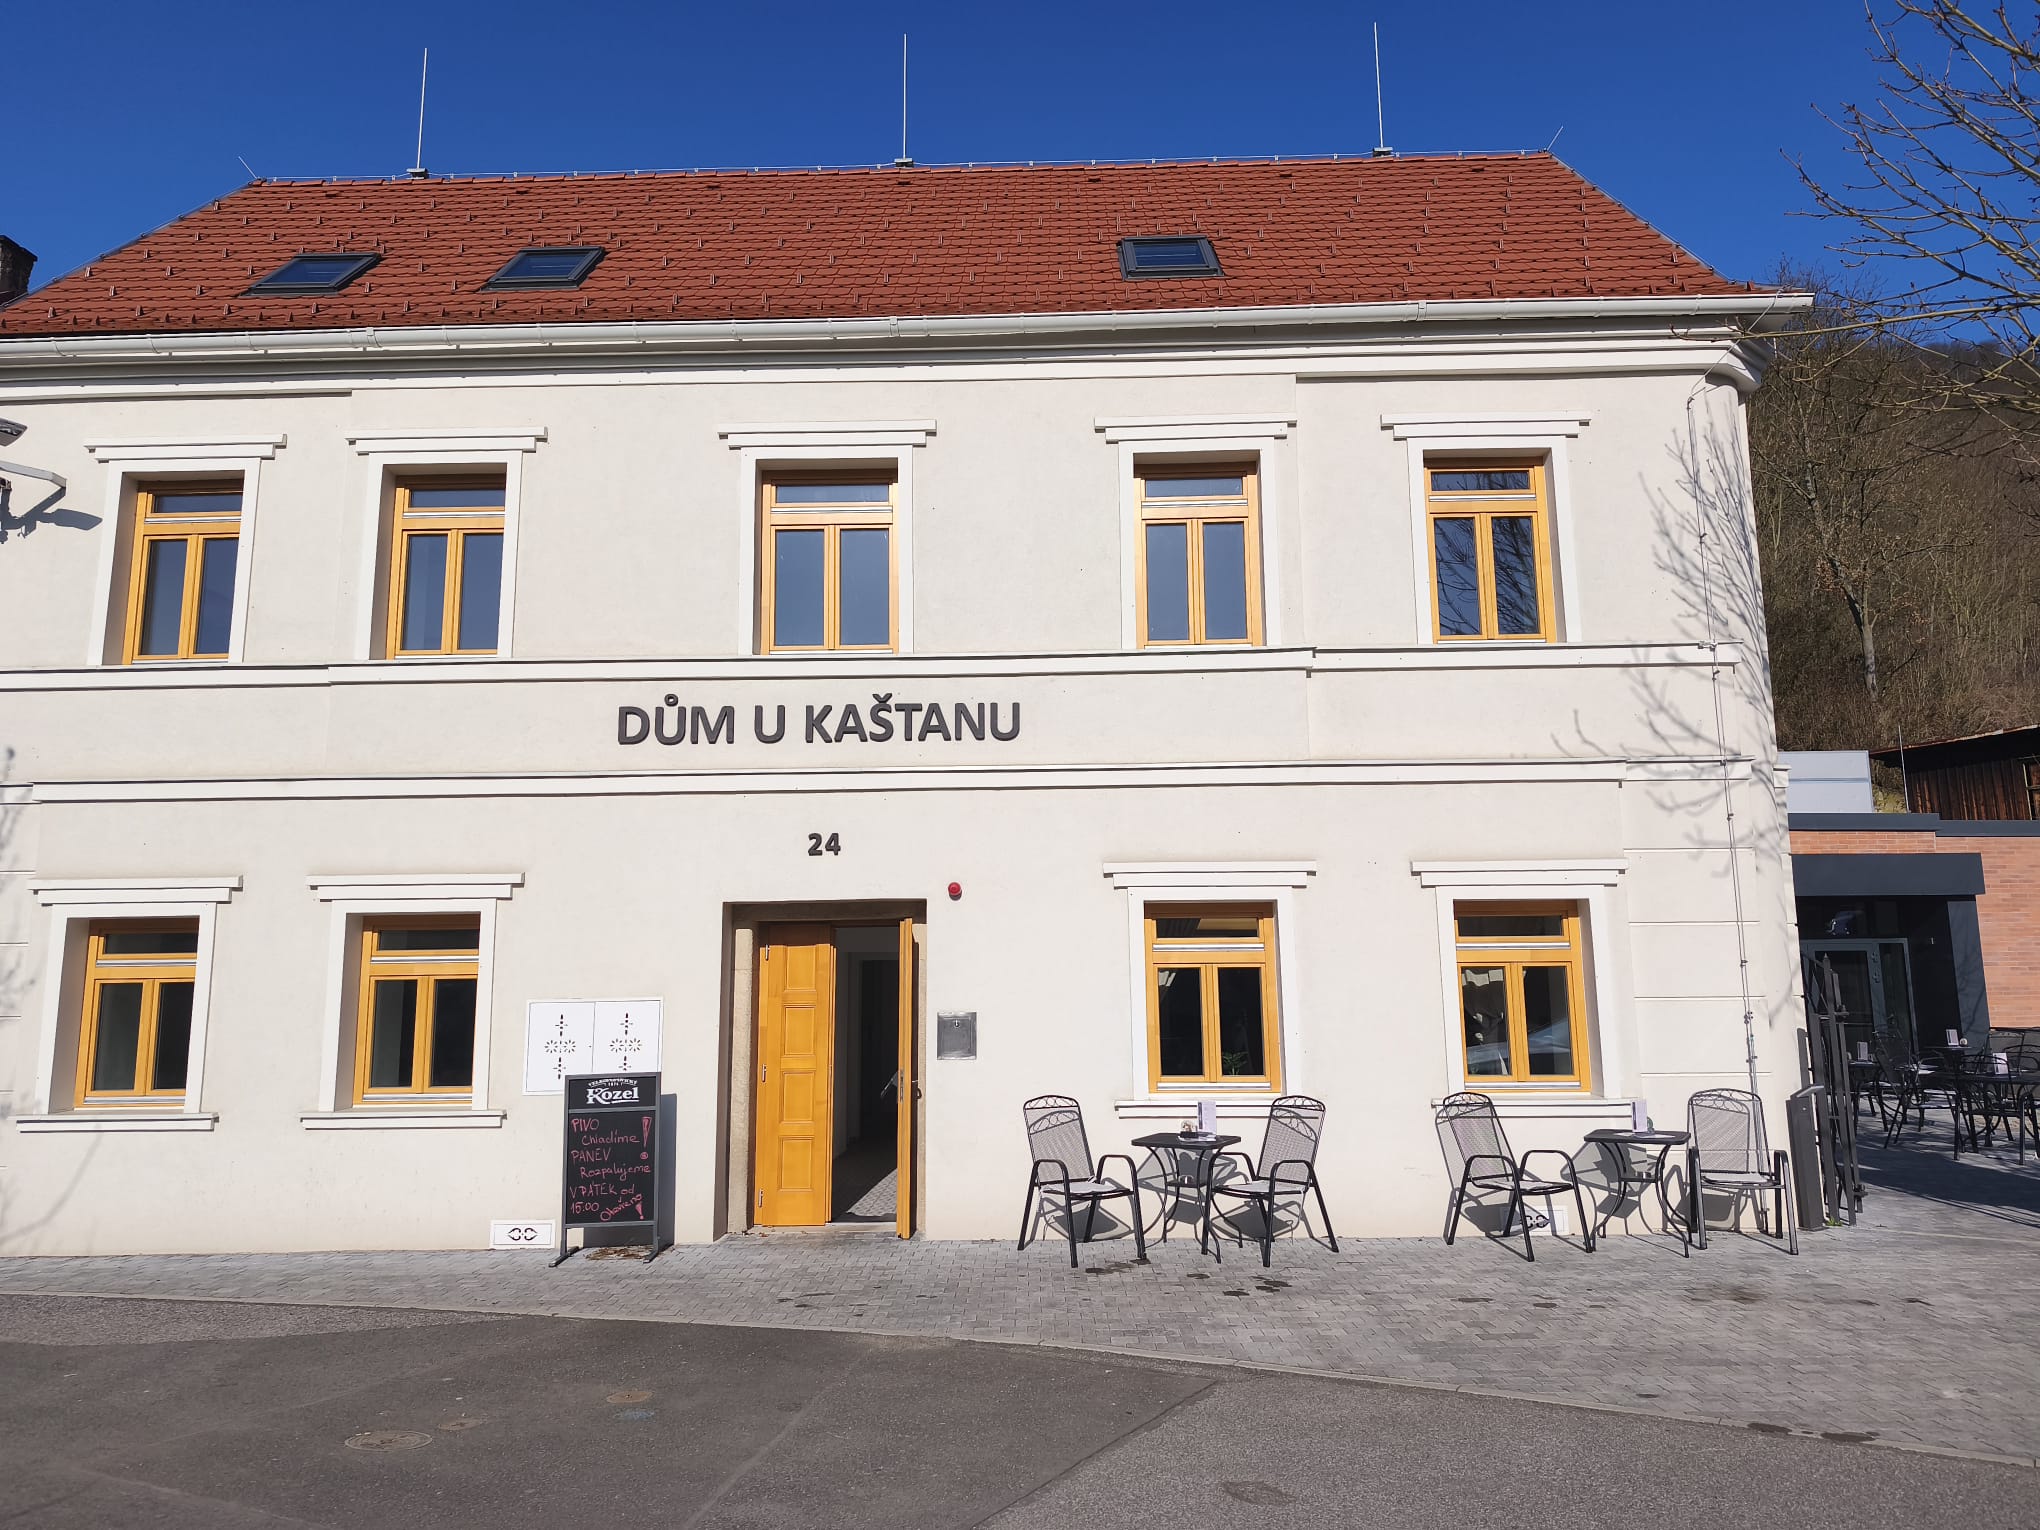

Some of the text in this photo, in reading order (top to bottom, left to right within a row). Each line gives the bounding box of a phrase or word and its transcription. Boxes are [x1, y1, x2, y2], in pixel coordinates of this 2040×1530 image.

[618, 692, 1021, 746] DŮM U KAŠTANU
[807, 832, 841, 856] 24
[586, 1087, 640, 1105] Kozel
[571, 1118, 599, 1133] PIVO
[620, 1183, 635, 1195] od
